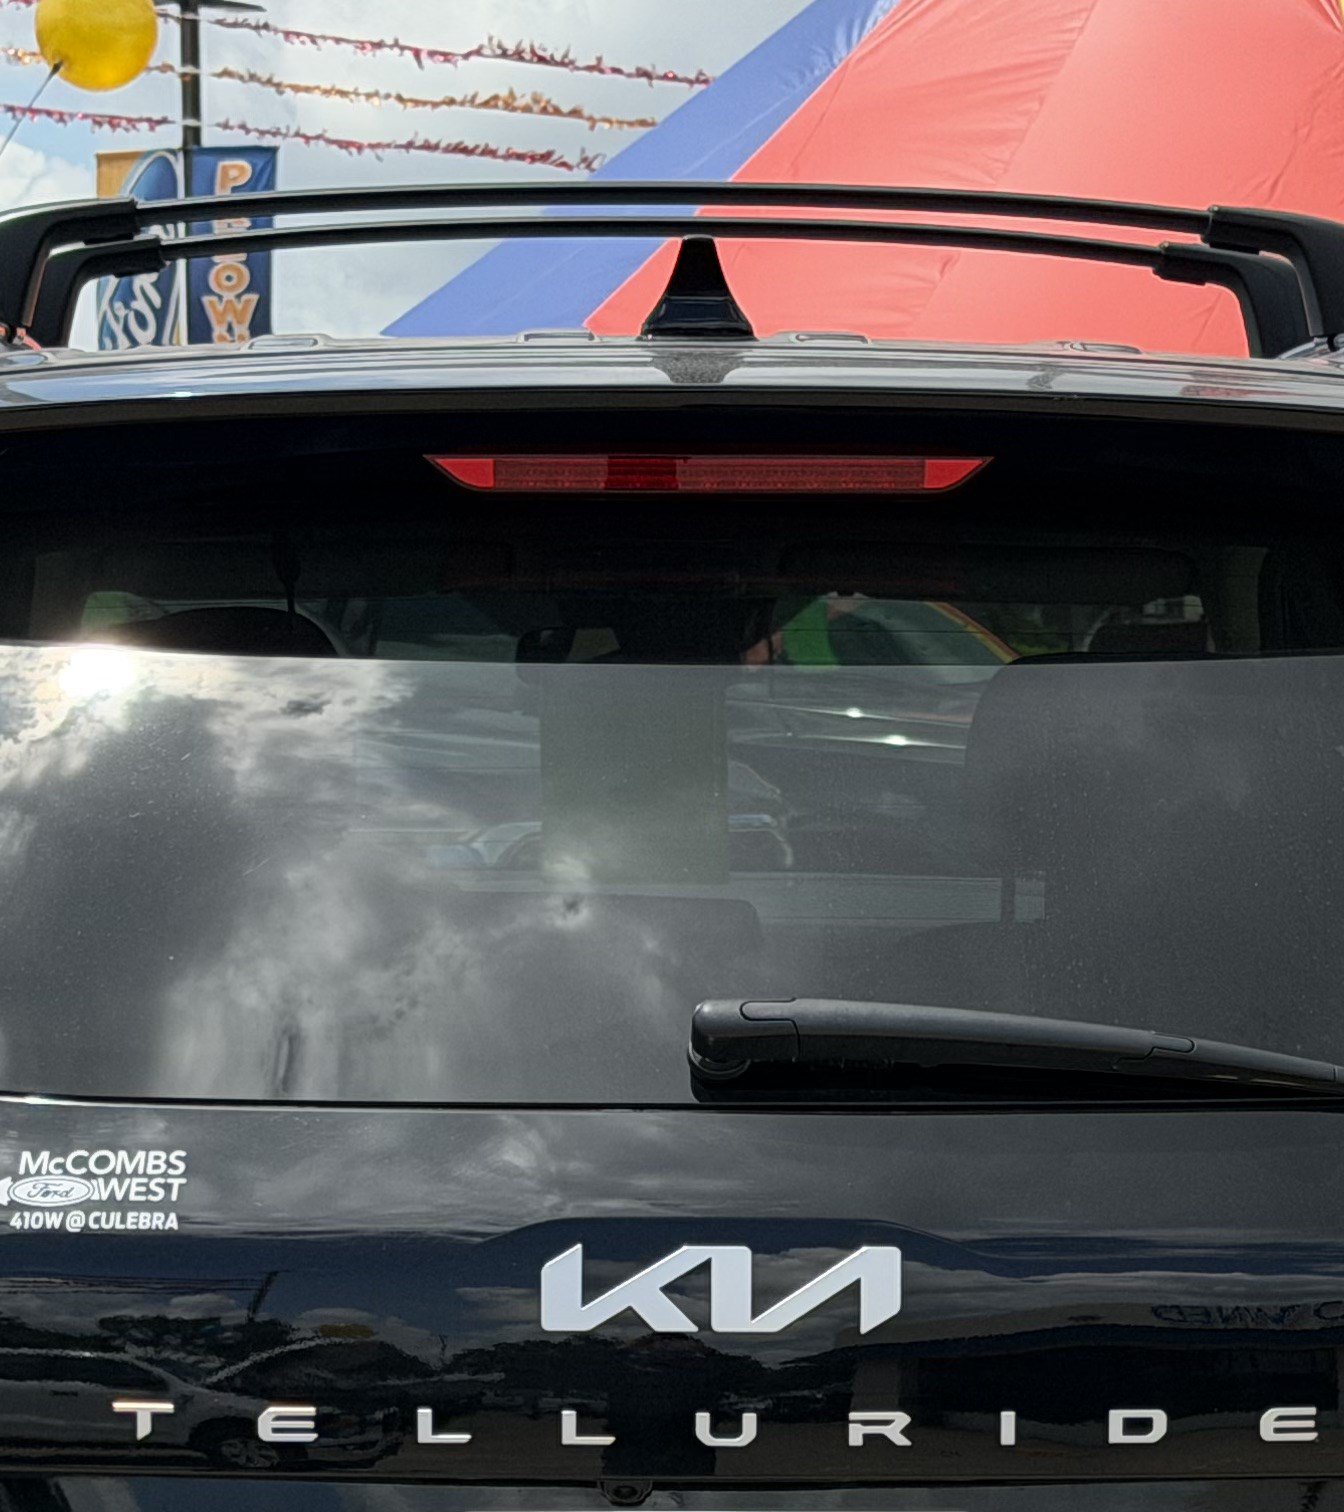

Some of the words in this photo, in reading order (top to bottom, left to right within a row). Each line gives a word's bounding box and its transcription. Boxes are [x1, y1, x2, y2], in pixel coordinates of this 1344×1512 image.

[18, 1150, 187, 1175] McCOMBS
[27, 1182, 75, 1198] Ford
[92, 1178, 187, 1201] WEST
[540, 1243, 904, 1334] KIA
[110, 1402, 1320, 1447] TELLURIDE
